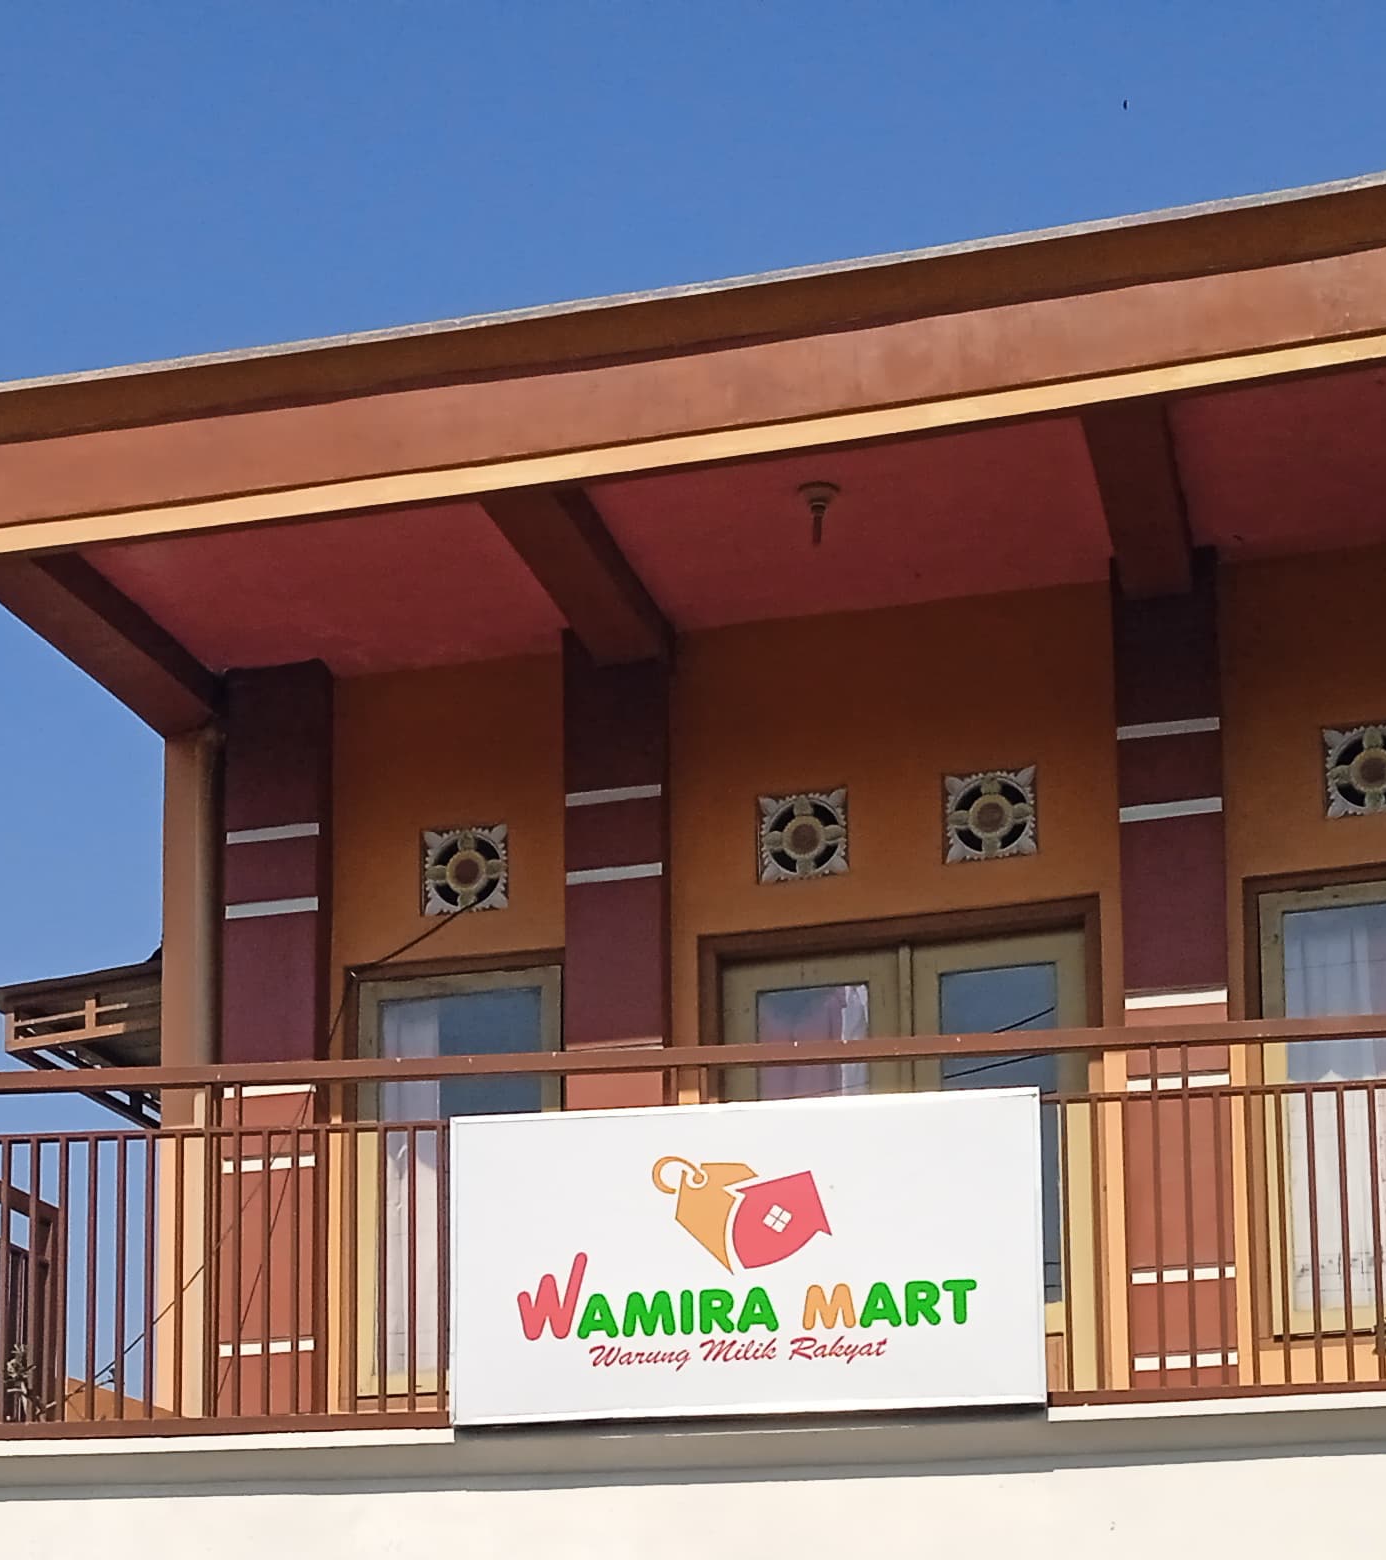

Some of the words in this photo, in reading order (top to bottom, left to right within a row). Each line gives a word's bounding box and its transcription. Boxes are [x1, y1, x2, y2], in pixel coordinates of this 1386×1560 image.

[517, 1252, 780, 1341] WAMIRA
[802, 1279, 978, 1330] MART
[589, 1343, 692, 1372] Warung
[700, 1338, 778, 1363] Milik
[790, 1337, 887, 1365] Rakyat
